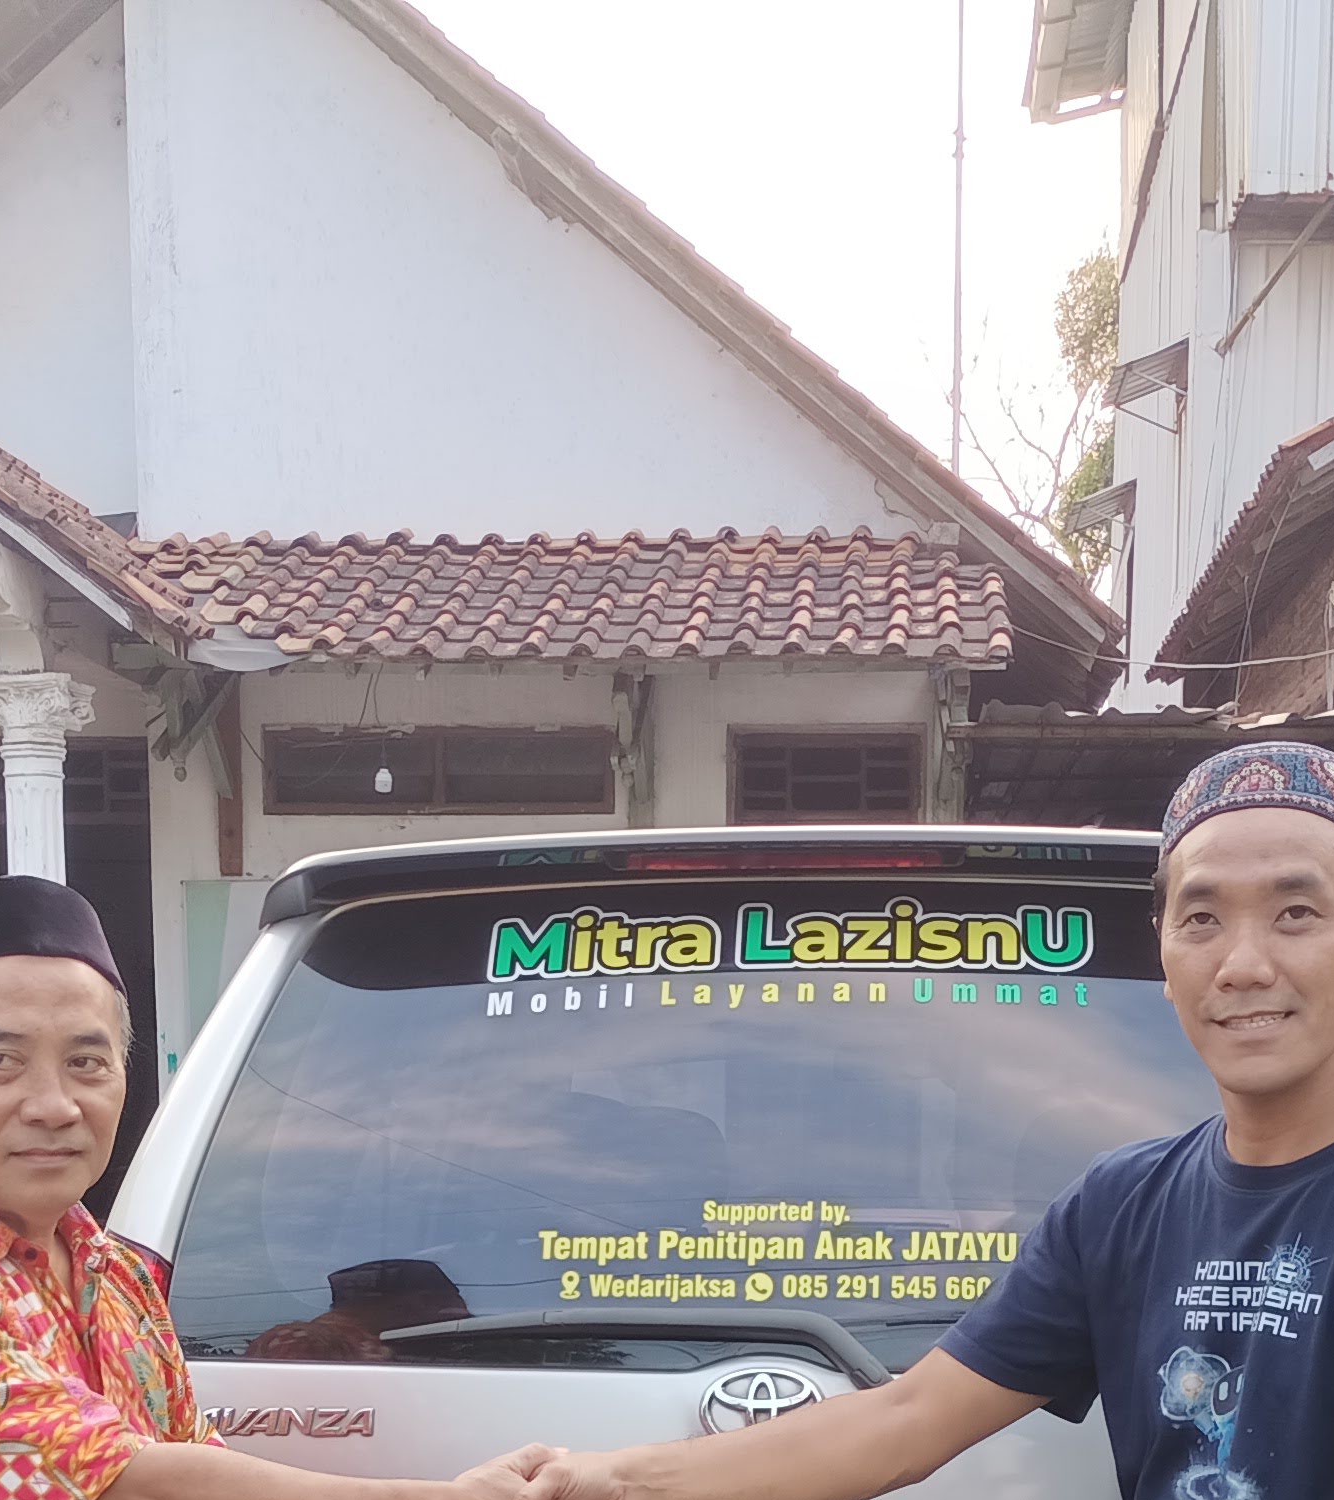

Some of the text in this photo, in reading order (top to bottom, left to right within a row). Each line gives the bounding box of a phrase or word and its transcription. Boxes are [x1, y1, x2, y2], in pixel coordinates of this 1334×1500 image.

[488, 897, 1094, 983] Mitra LazisnU
[487, 978, 1091, 1018] Mobil Layanan Ummat
[702, 1200, 851, 1226] Supported by.
[538, 1230, 1018, 1267] Tempat Penitipan Anak JATAYU
[589, 1273, 736, 1303] Wedarijaksa
[782, 1275, 828, 1299] 085
[836, 1275, 881, 1299] 291
[890, 1275, 937, 1300] 545
